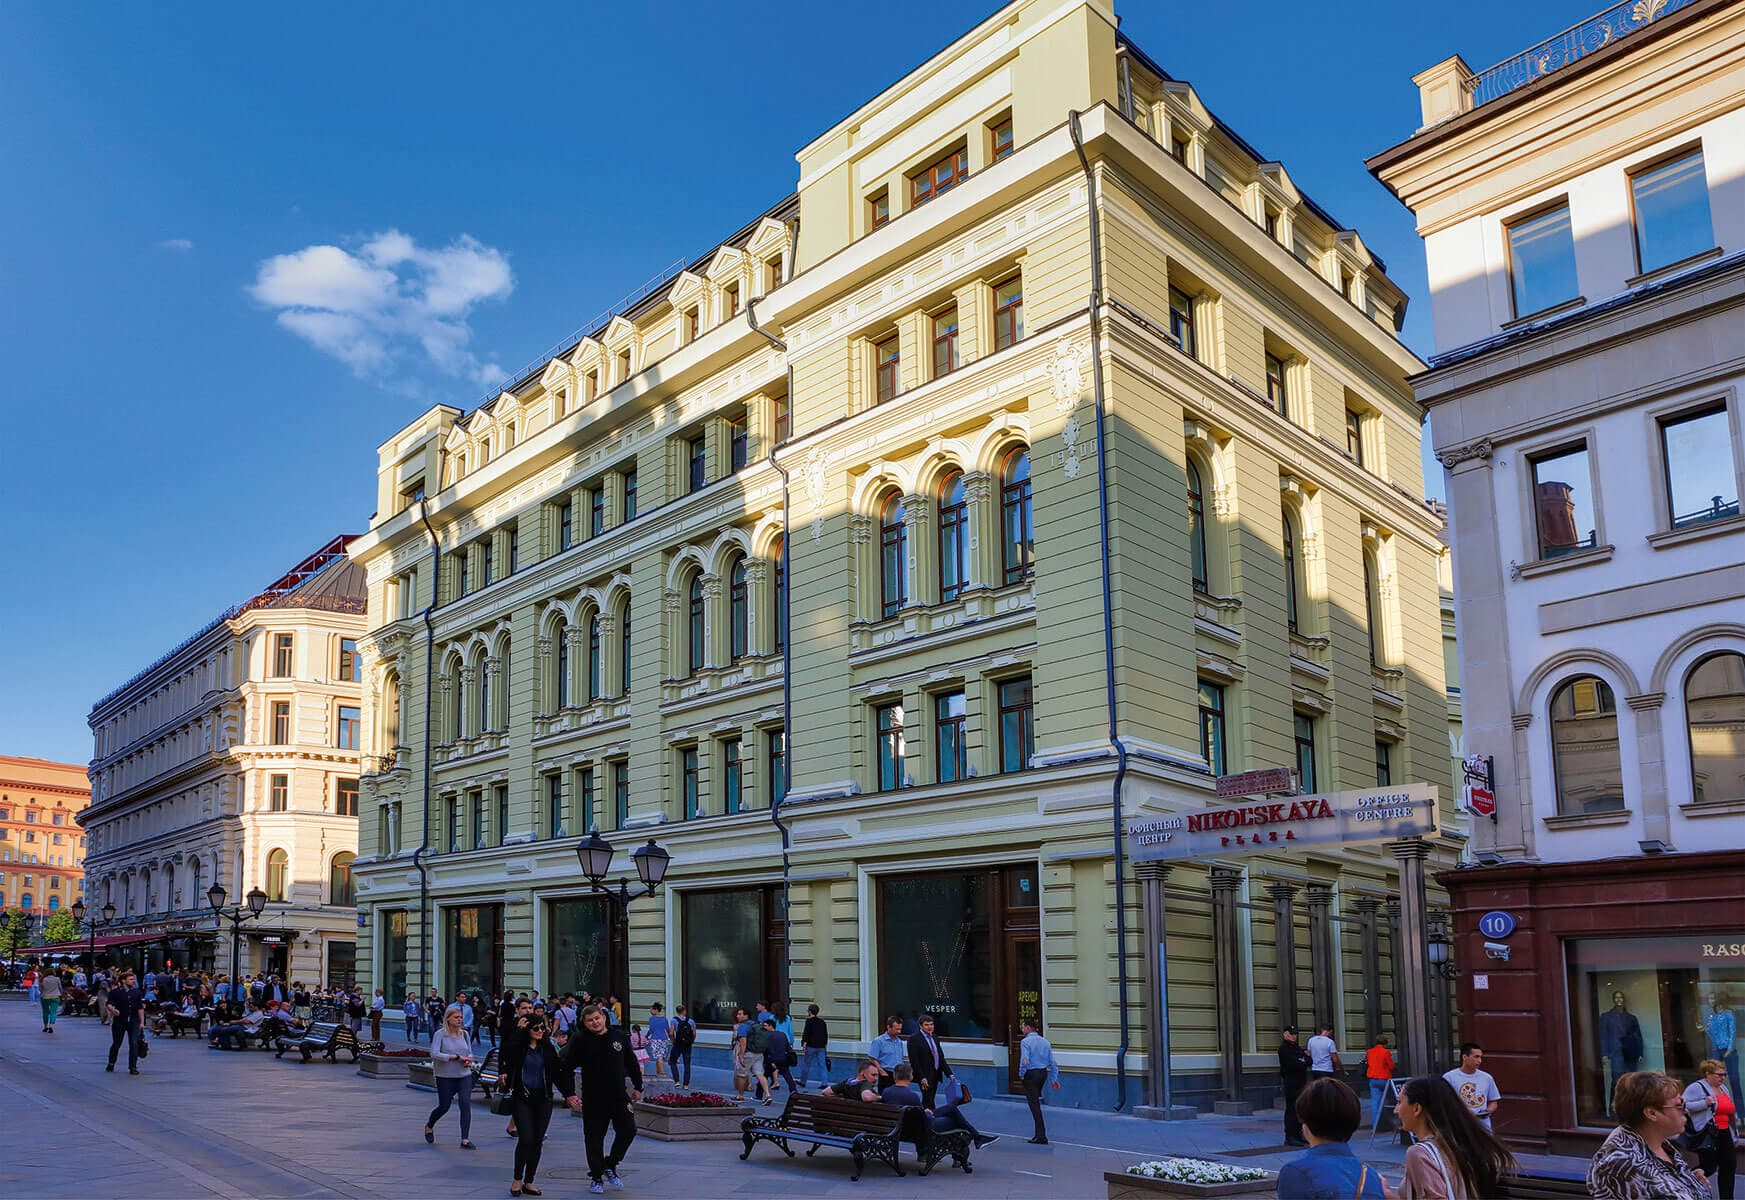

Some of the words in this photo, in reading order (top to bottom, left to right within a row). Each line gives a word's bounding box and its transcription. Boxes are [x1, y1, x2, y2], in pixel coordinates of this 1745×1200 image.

[1357, 792, 1409, 808] OFFICE
[1355, 807, 1413, 822] CENTRE
[1128, 817, 1182, 834] ОФИСНЫЙ
[1138, 832, 1172, 846] ЦЕНТР
[1486, 917, 1505, 933] 10
[925, 1004, 956, 1013] VESPER
